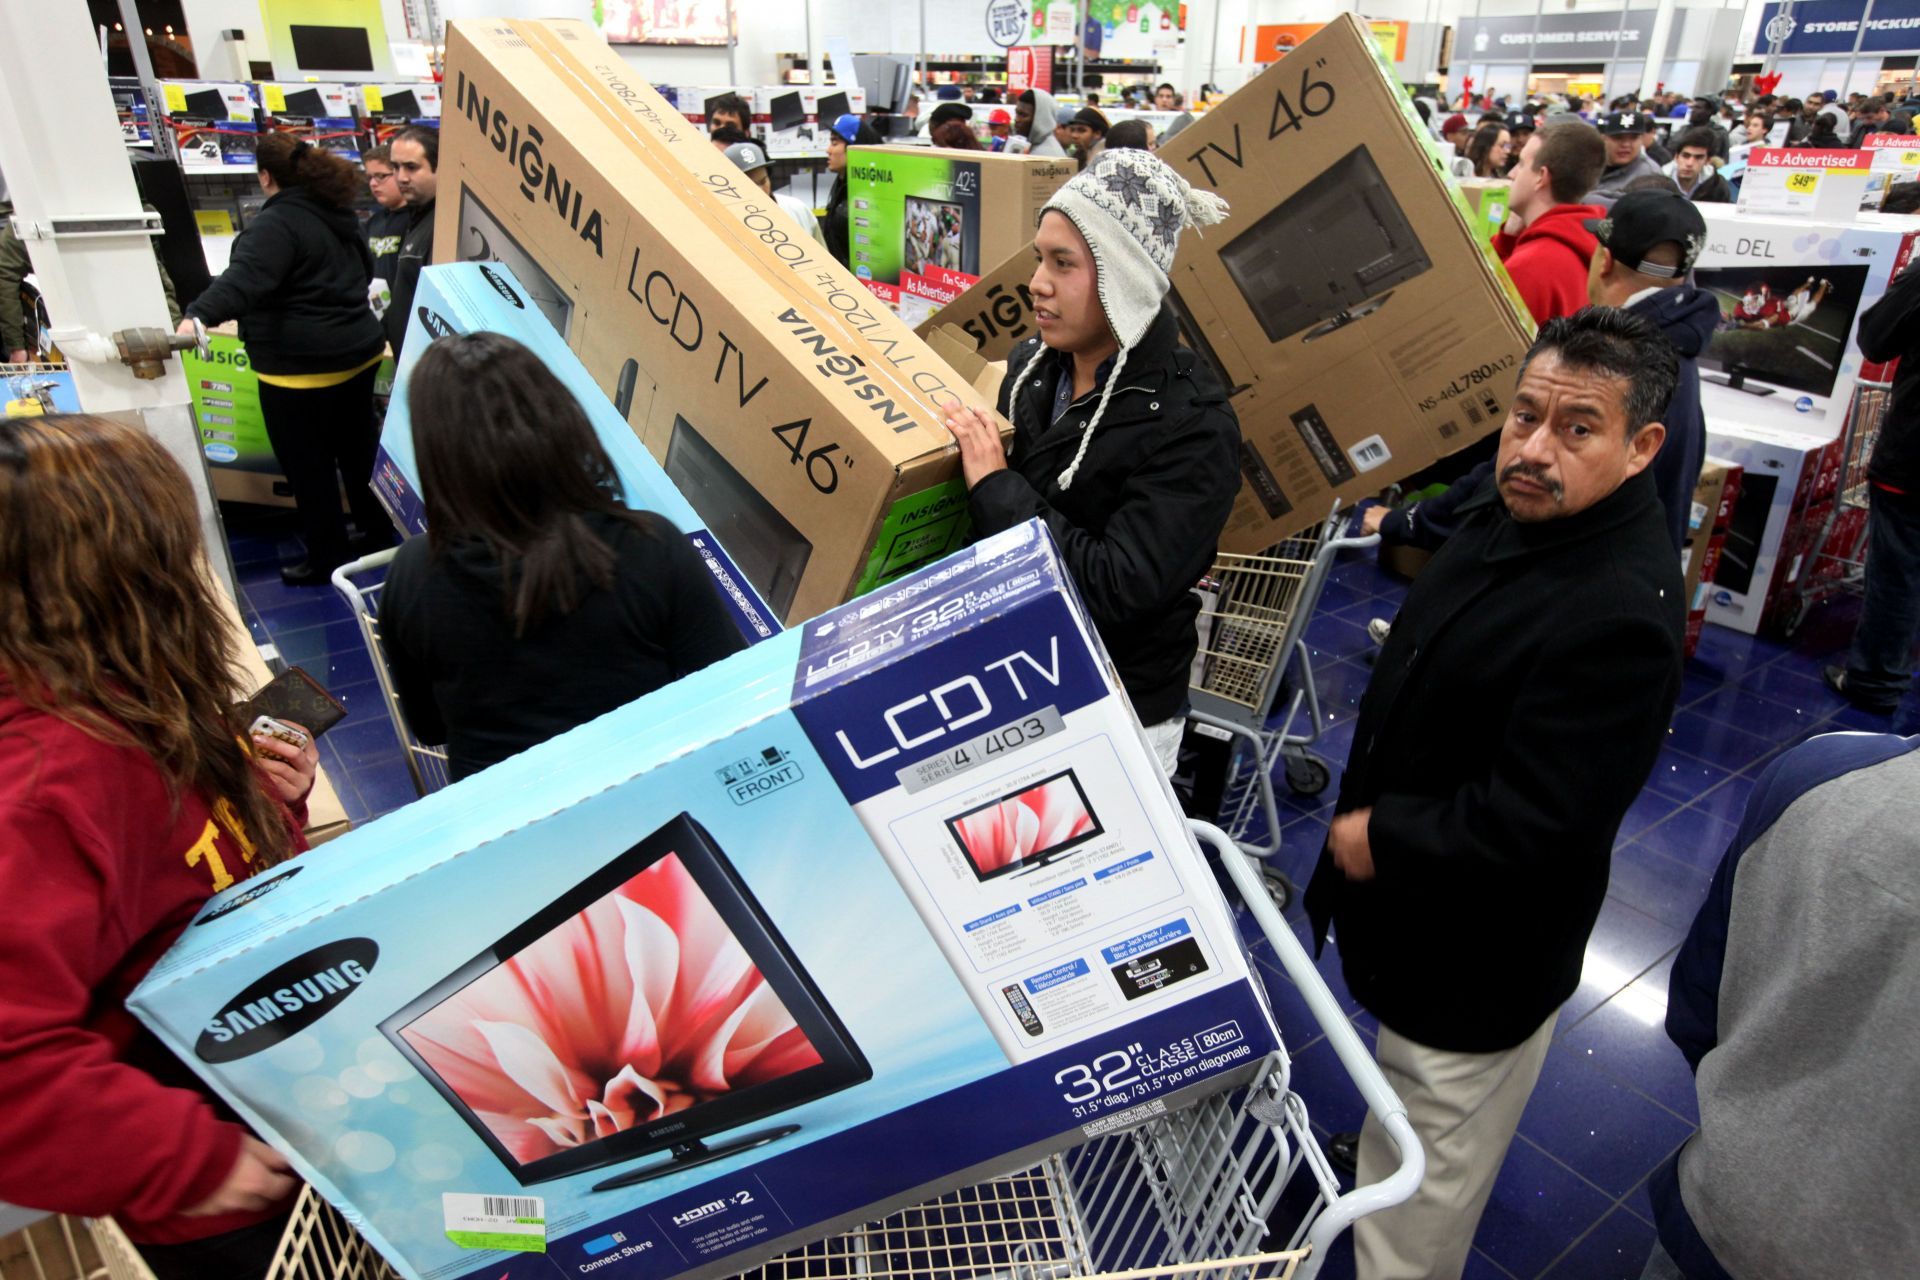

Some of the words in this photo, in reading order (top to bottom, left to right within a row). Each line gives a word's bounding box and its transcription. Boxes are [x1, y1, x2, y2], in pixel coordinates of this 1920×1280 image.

[994, 16, 1018, 37] PLUS
[1500, 32, 1575, 44] CUSTOMER
[1576, 30, 1639, 42] SERVICE
[1804, 21, 1859, 33] STORE
[1008, 50, 1030, 71] HOT
[1187, 123, 1244, 187] TV
[1268, 57, 1336, 141] 46"
[1872, 138, 1884, 147] As
[1032, 166, 1070, 178] INSIGNIA
[1762, 152, 1779, 165] As
[1781, 153, 1858, 167] Advertised
[851, 164, 893, 186] INSIGNIA
[744, 204, 813, 270] 1080p
[1736, 238, 1775, 258] DEL
[457, 70, 604, 258] INSIGNIA
[627, 247, 703, 351] LCD
[714, 330, 769, 408] TV
[771, 418, 855, 494] 46"
[486, 268, 518, 306] SAMSUNG
[877, 285, 892, 300] Sale
[907, 278, 917, 292] As
[916, 281, 955, 303] Advertised
[816, 272, 881, 334] 120Hz
[867, 337, 915, 368] TV
[777, 307, 918, 434] INSIGNIA
[1417, 353, 1518, 413] NS-46L780A12
[807, 640, 870, 677] LCD
[873, 624, 904, 645] TV
[835, 675, 992, 769] LCD
[984, 636, 1059, 700] TV
[916, 755, 947, 775] SERIES
[986, 717, 1046, 755] 403
[735, 767, 794, 800] FRONT
[1113, 949, 1127, 959] Bloc
[1126, 945, 1136, 954] de
[1135, 937, 1157, 951] prises
[1126, 936, 1143, 947] Jack
[1142, 930, 1159, 941] Pack
[1030, 971, 1052, 984] Remote
[1052, 963, 1074, 976] Control
[1034, 969, 1075, 991] Télécommande
[204, 959, 370, 1042] SAMSUNG
[1055, 1042, 1143, 1103] 32"
[1136, 1038, 1193, 1067] CLASS
[1202, 1027, 1237, 1048] 80cm
[1141, 1049, 1199, 1077] CLASSE
[1184, 1065, 1199, 1077] en
[1199, 1044, 1251, 1073] diagonale
[1082, 1119, 1106, 1131] CLAMP
[1107, 1110, 1131, 1122] BELOW
[1132, 1104, 1147, 1114] THIS
[1147, 1098, 1163, 1108] LINE
[649, 1122, 686, 1138] SAMSUNG
[672, 1198, 726, 1226] HDMI
[579, 1252, 622, 1274] Connect
[623, 1239, 654, 1258] Share
